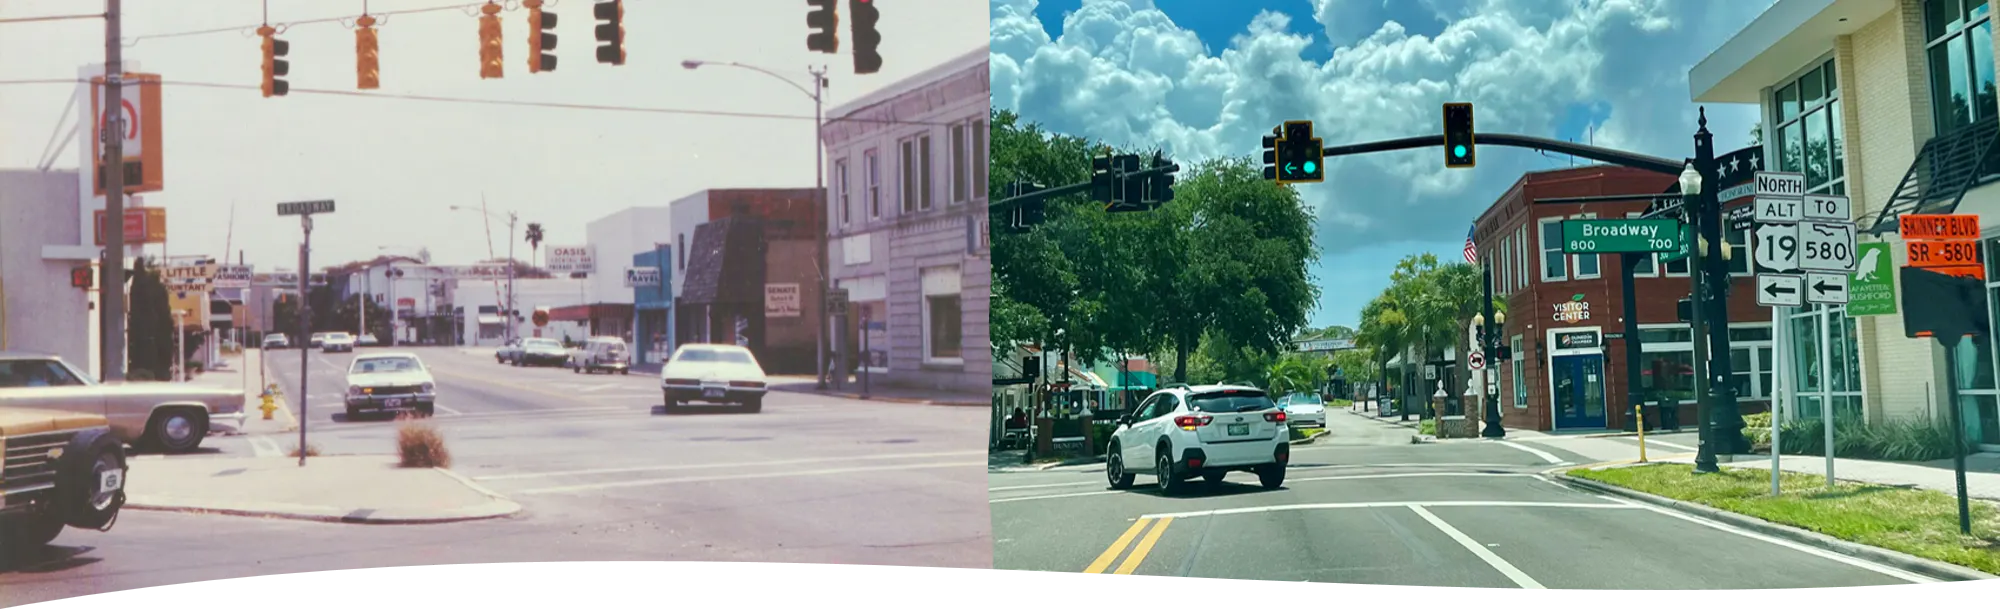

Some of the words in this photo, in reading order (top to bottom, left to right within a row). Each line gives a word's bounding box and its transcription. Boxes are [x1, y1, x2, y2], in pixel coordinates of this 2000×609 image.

[1758, 176, 1802, 193] NORTH
[1766, 203, 1795, 217] ALT
[1815, 200, 1836, 214] TO
[1583, 224, 1658, 238] Broadway
[1903, 218, 1948, 236] SKINNER
[1951, 218, 1976, 236] BLVD
[1571, 240, 1596, 250] 800
[1648, 239, 1673, 249] 700
[1766, 235, 1797, 261] 19
[1806, 241, 1847, 260] 580
[554, 248, 587, 256] OASIS
[1909, 244, 1929, 261] SR
[1944, 243, 1973, 261] 580
[166, 267, 206, 277] LITTLE
[767, 286, 797, 294] SENATE
[1553, 302, 1589, 311] VISITOR
[1553, 311, 1590, 321] CENTER
